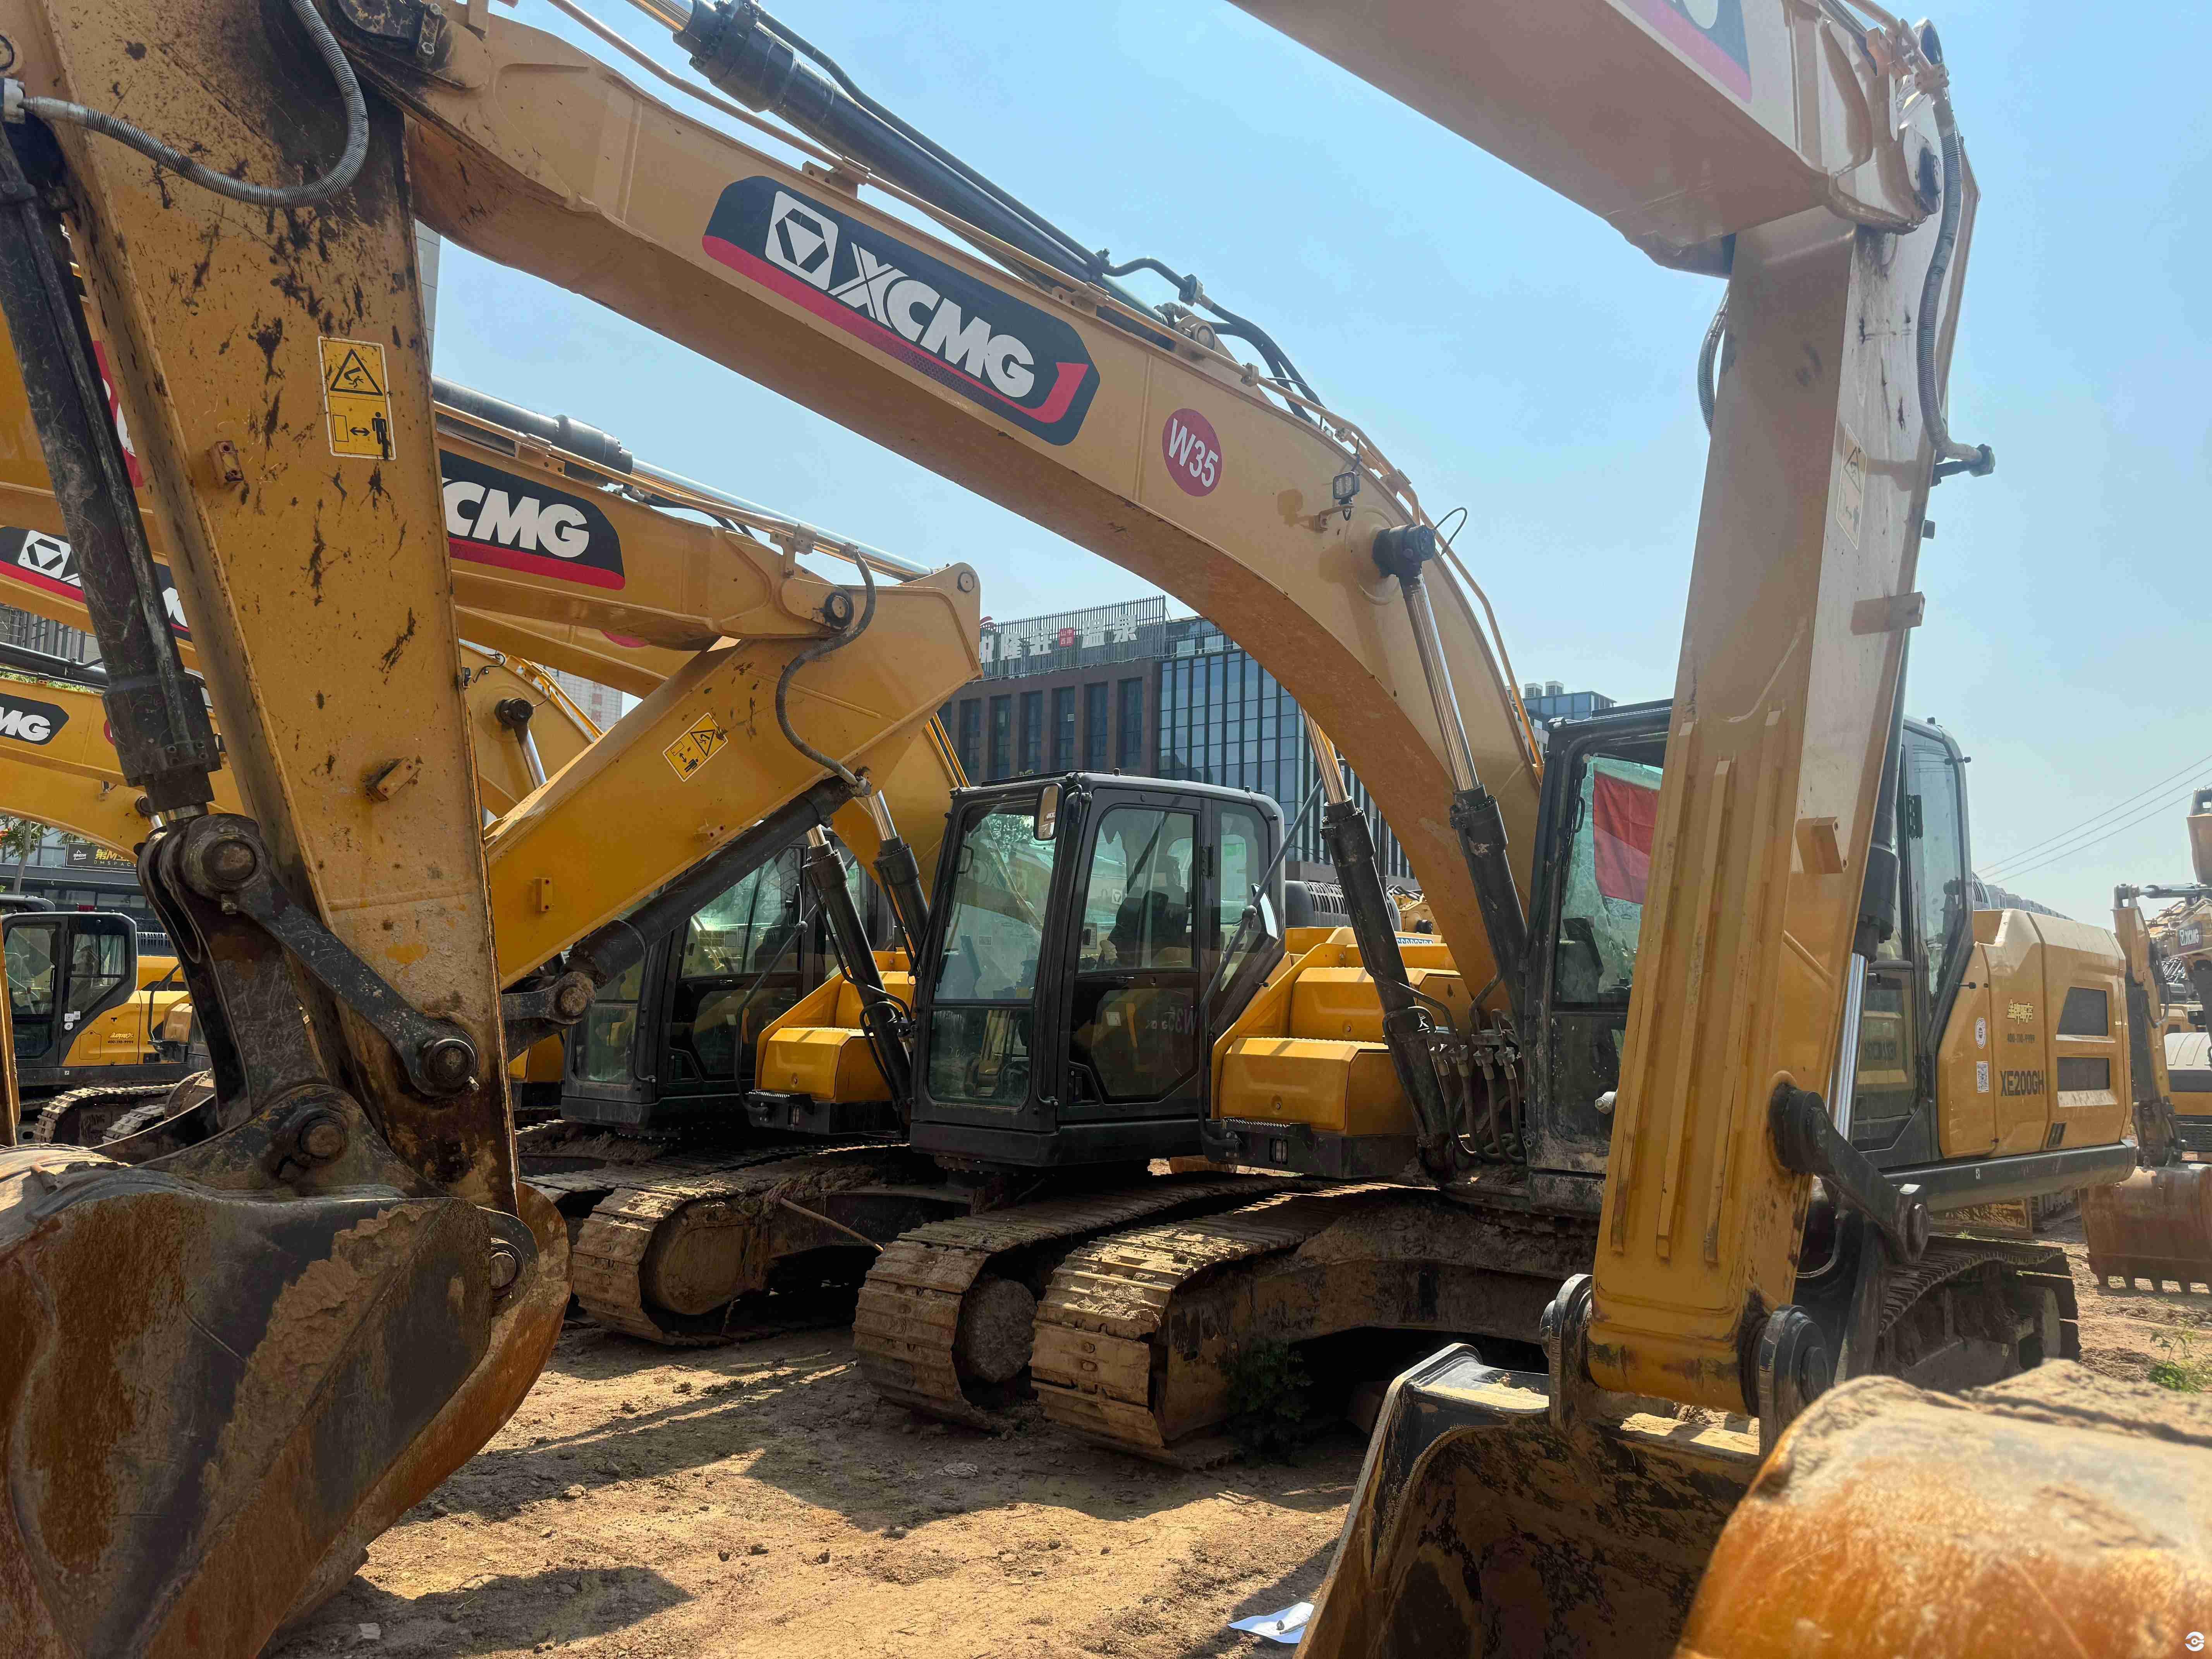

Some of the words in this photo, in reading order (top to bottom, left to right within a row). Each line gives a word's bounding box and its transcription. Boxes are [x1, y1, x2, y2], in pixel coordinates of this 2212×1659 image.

[828, 241, 1035, 398] XCMG
[1168, 418, 1219, 488] W35
[441, 476, 590, 558] CMG
